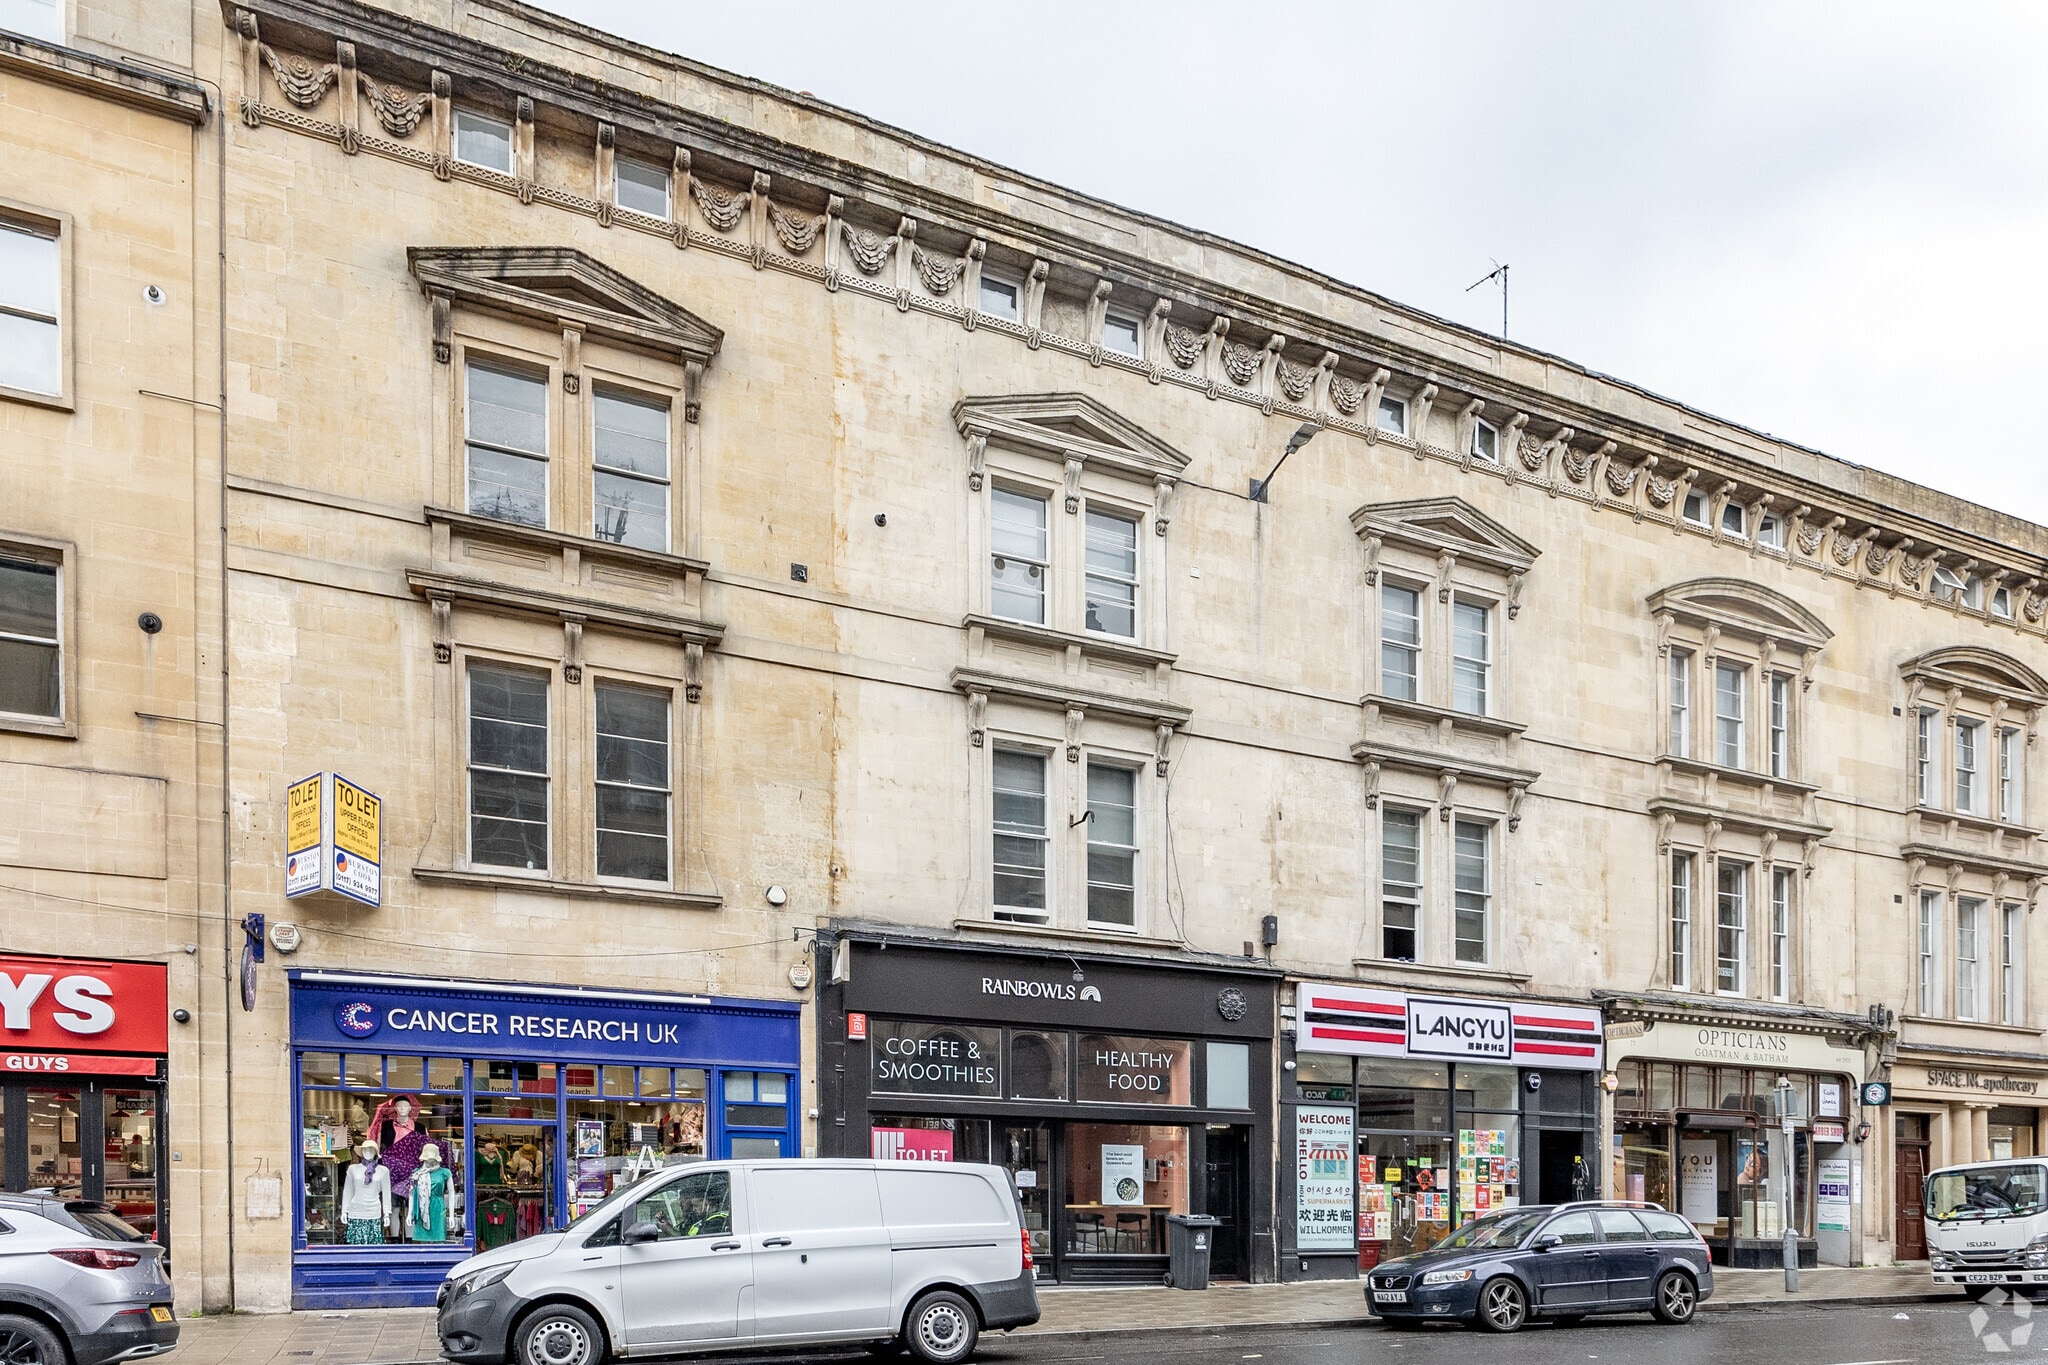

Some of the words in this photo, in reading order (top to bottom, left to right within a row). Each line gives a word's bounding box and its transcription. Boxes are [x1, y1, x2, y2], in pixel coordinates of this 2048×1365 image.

[290, 788, 300, 808] TO
[303, 780, 318, 804] LET
[338, 782, 354, 806] TO
[357, 793, 378, 818] LET
[296, 818, 311, 831] OFFICES
[340, 808, 358, 824] UPPER
[358, 816, 375, 831] FLOOR
[346, 822, 368, 840] OFFICES
[301, 862, 315, 872] COOK
[348, 858, 378, 876] BURSTON
[353, 868, 372, 883] COOK
[353, 880, 364, 890] 934
[365, 884, 378, 896] 9977
[982, 978, 1076, 1000] RAINBOWLS
[0, 972, 116, 1034] YS
[387, 1008, 499, 1035] CANCER
[509, 1015, 638, 1042] RESEARCH
[646, 1023, 678, 1044] UK
[1416, 1014, 1505, 1040] LANGYU
[1606, 1024, 1642, 1037] OPTICIANS
[1698, 1029, 1787, 1051] OPTICIANS
[885, 1038, 959, 1058] COFFEE
[967, 1042, 981, 1060] &
[1695, 1048, 1740, 1060] GOATMAN
[1753, 1054, 1789, 1063] BATHAM
[6, 1056, 69, 1070] GUYS
[1096, 1050, 1173, 1069] HEALTHY
[879, 1061, 994, 1084] SMOOTHIES
[1109, 1074, 1161, 1091] FOOD
[1299, 1114, 1351, 1125] WELCOME
[1814, 1126, 1829, 1136] ARBER
[1830, 1127, 1844, 1137] SHOP
[896, 1149, 917, 1160] TO
[1299, 1139, 1307, 1180] HELLO
[1682, 1156, 1713, 1165] YOU
[254, 1157, 269, 1173] 71
[1299, 1209, 1351, 1222] 欢迎光临
[1300, 1226, 1352, 1234] WILLKOMMEN
